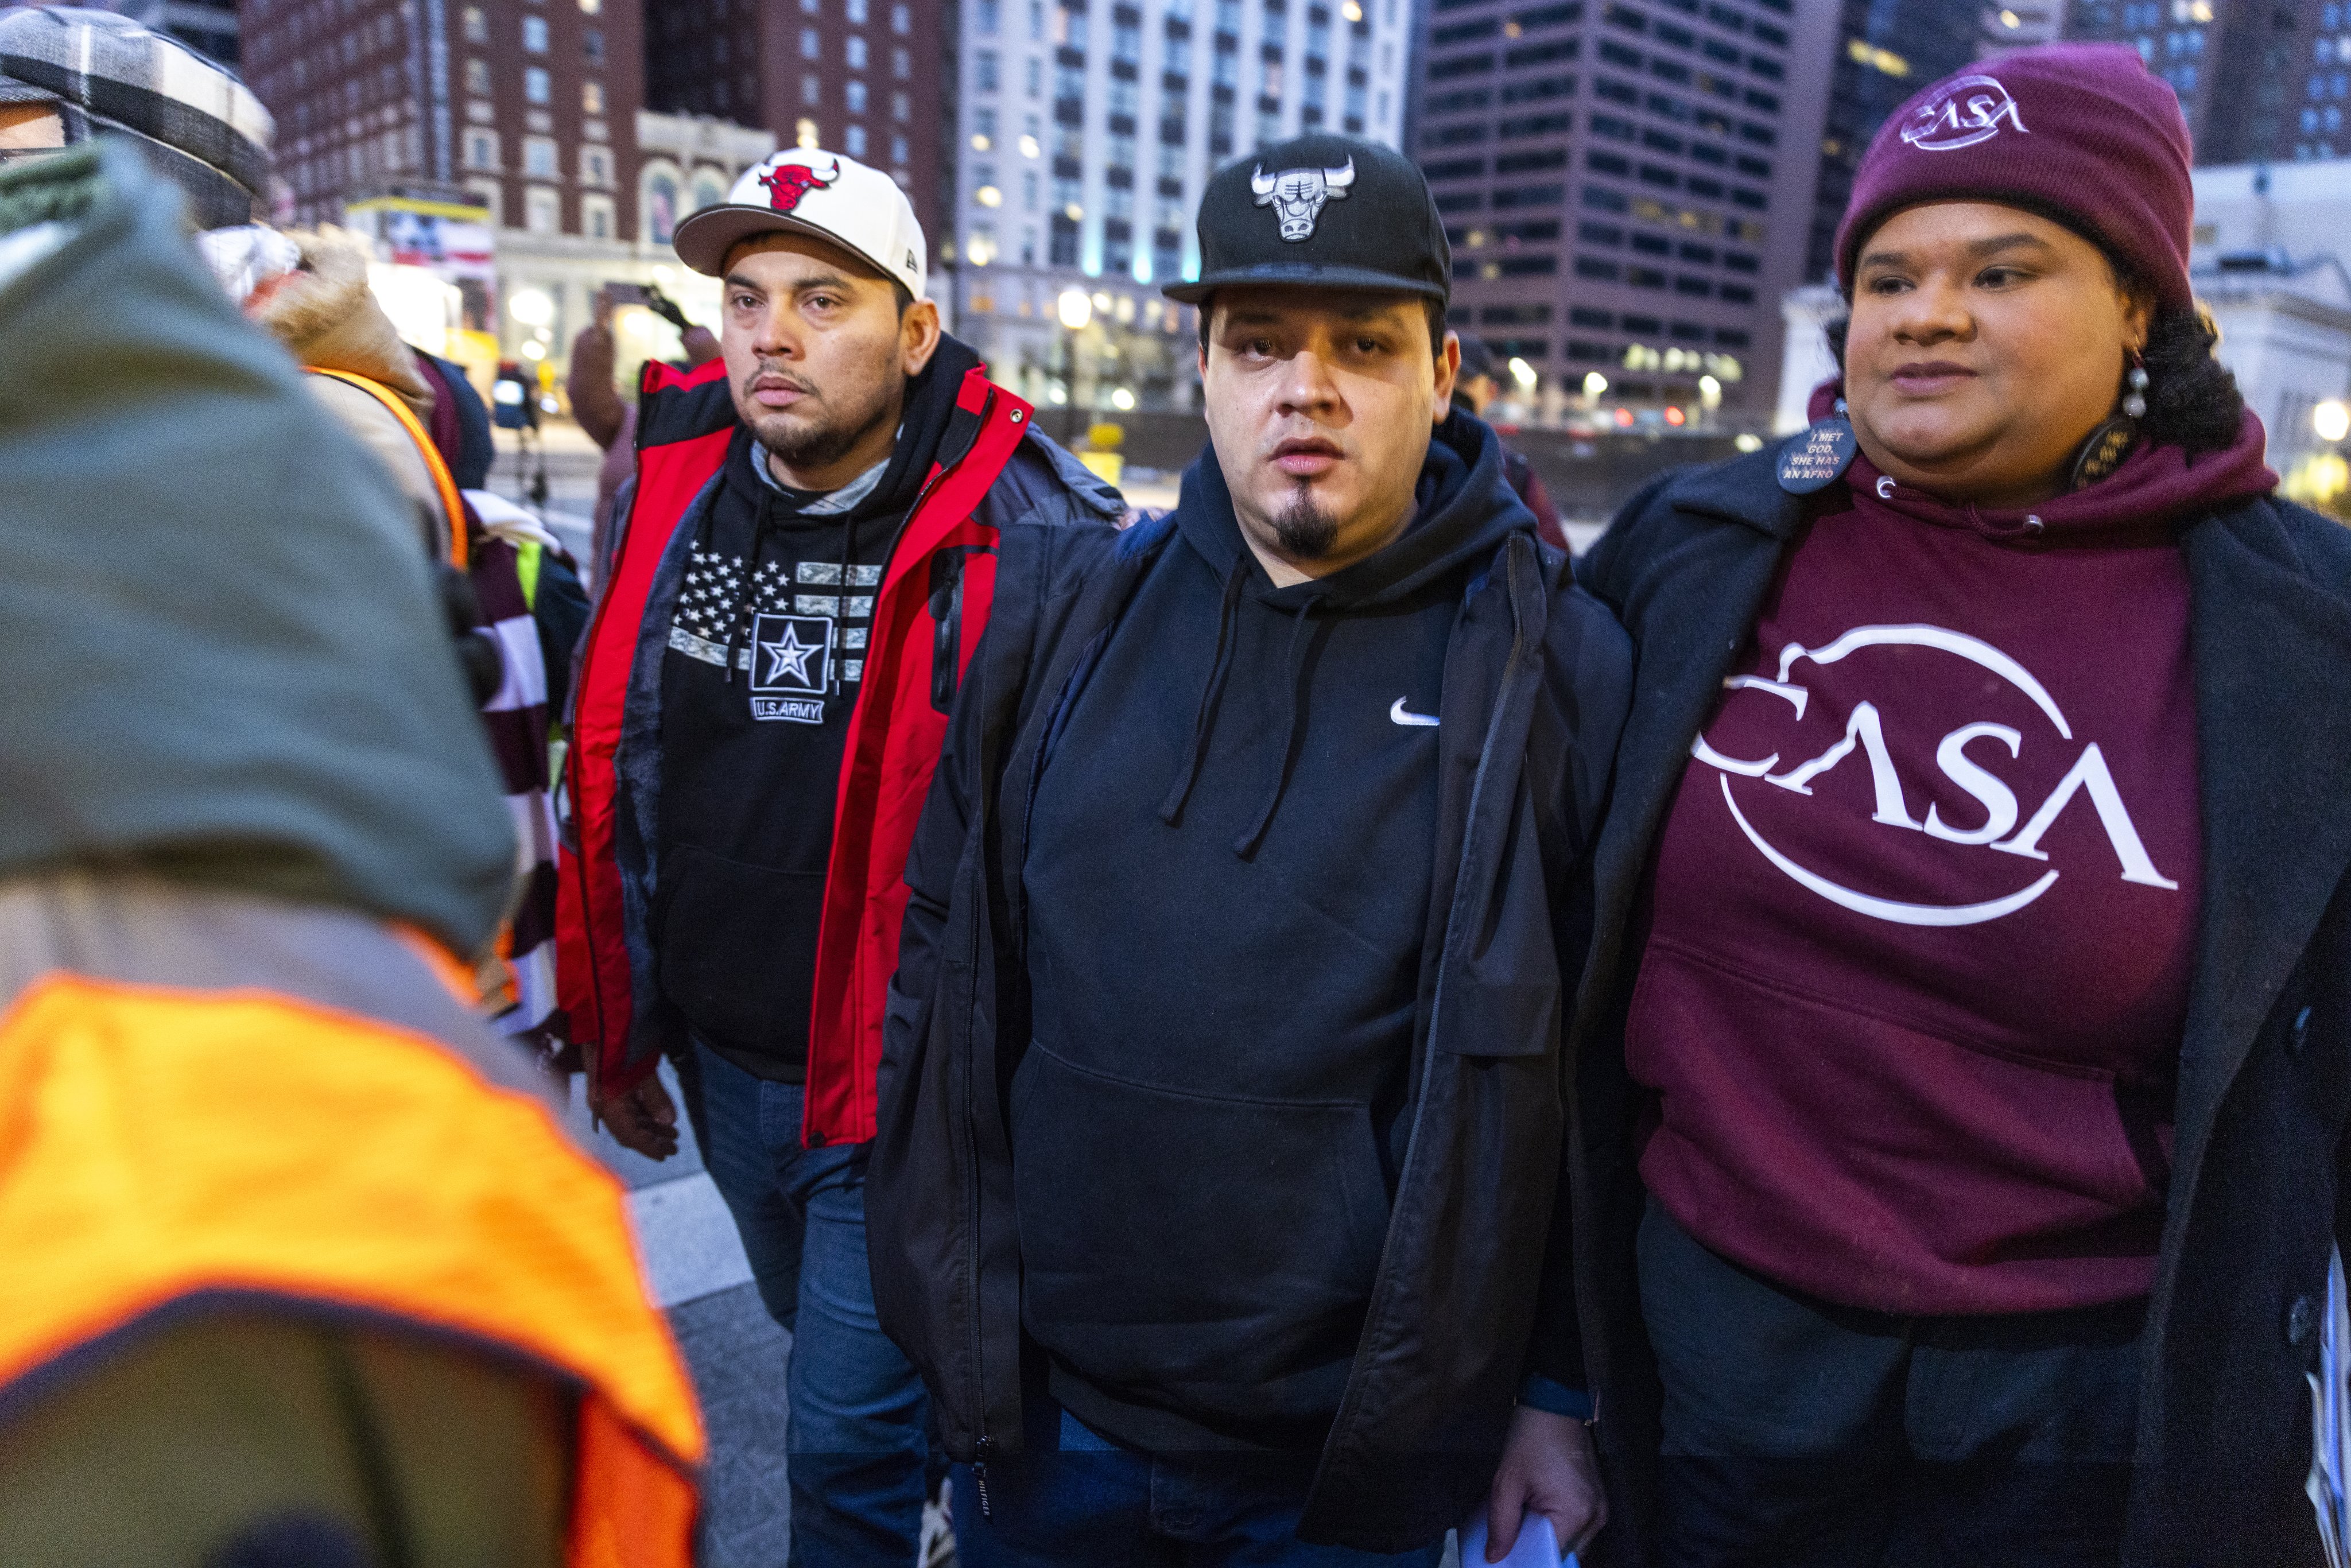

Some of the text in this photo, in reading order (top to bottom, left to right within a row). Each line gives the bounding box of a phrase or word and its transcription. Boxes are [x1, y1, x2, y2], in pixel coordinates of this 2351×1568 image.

[1900, 94, 2030, 143] CASA
[1811, 433, 1844, 442] I MET
[1807, 445, 1833, 455] GOD,
[1791, 456, 1840, 465] SHE HAS
[1783, 470, 1834, 479] AN AFRO
[1690, 674, 2179, 890] CASA
[978, 1480, 990, 1516] HILFIGER
